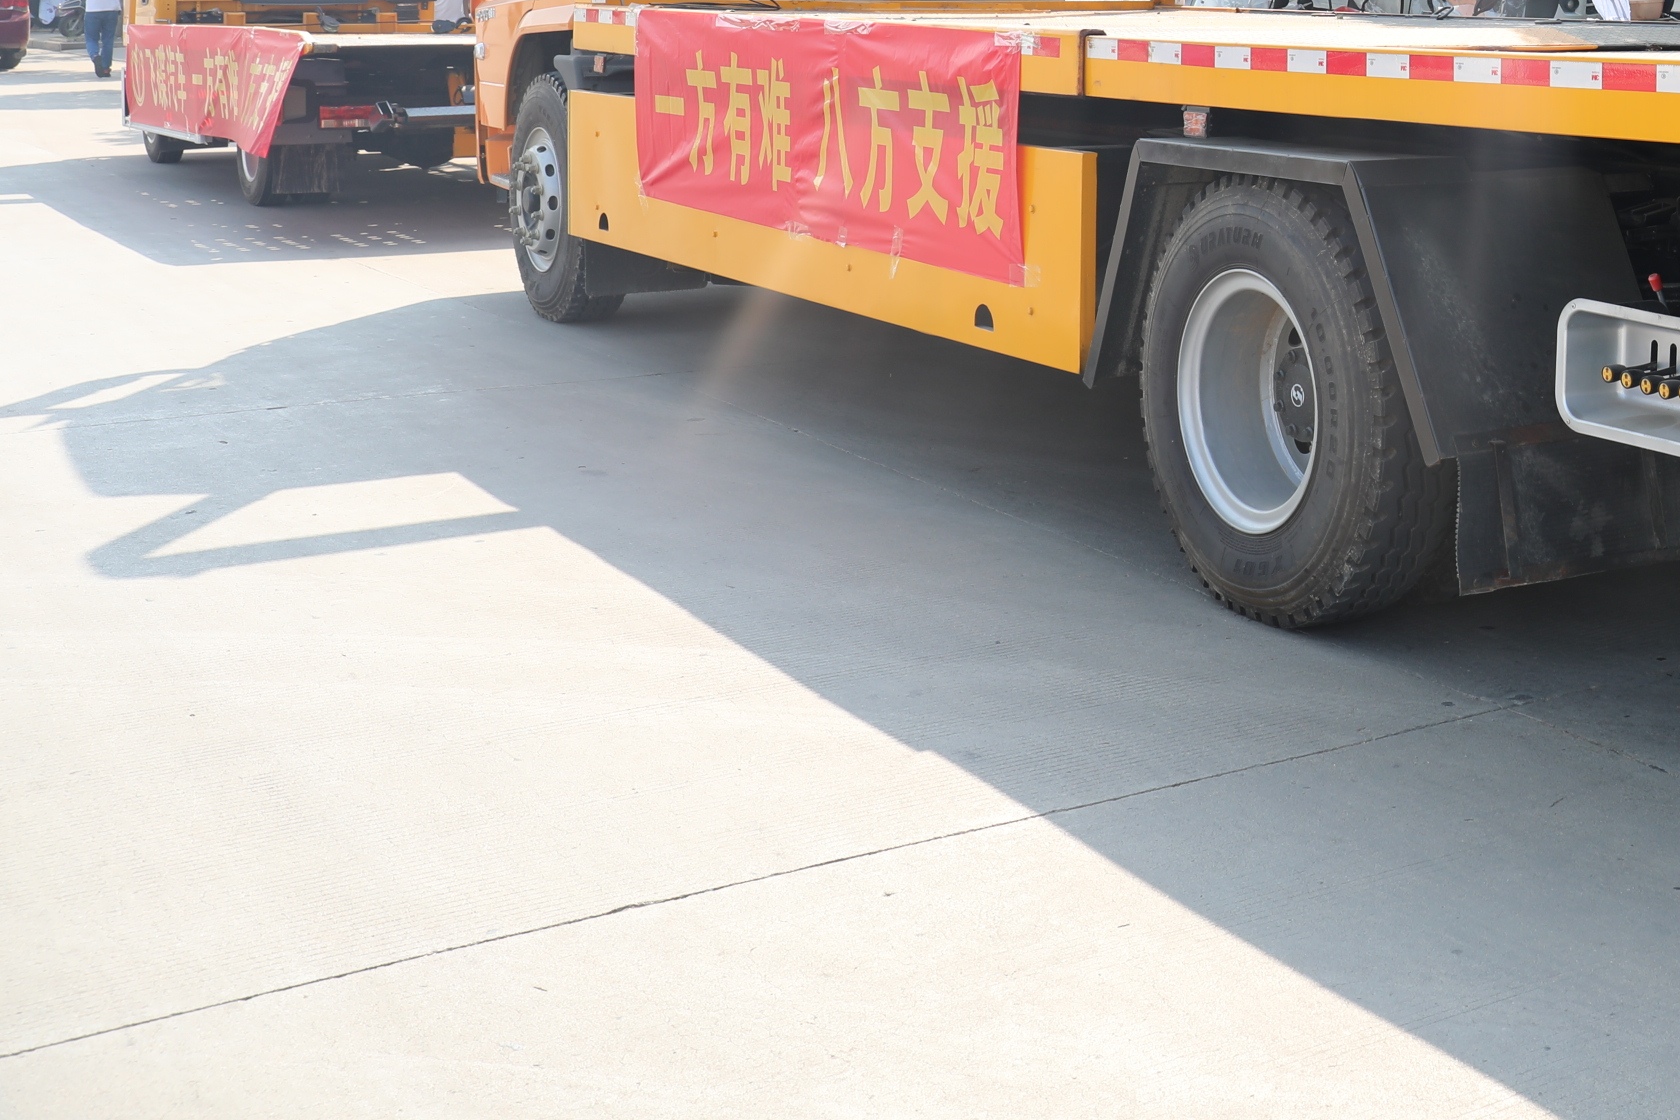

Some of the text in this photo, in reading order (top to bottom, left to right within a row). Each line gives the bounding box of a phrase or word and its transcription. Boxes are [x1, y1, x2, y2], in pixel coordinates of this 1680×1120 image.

[654, 50, 1005, 241] 一方有难 八方支援
